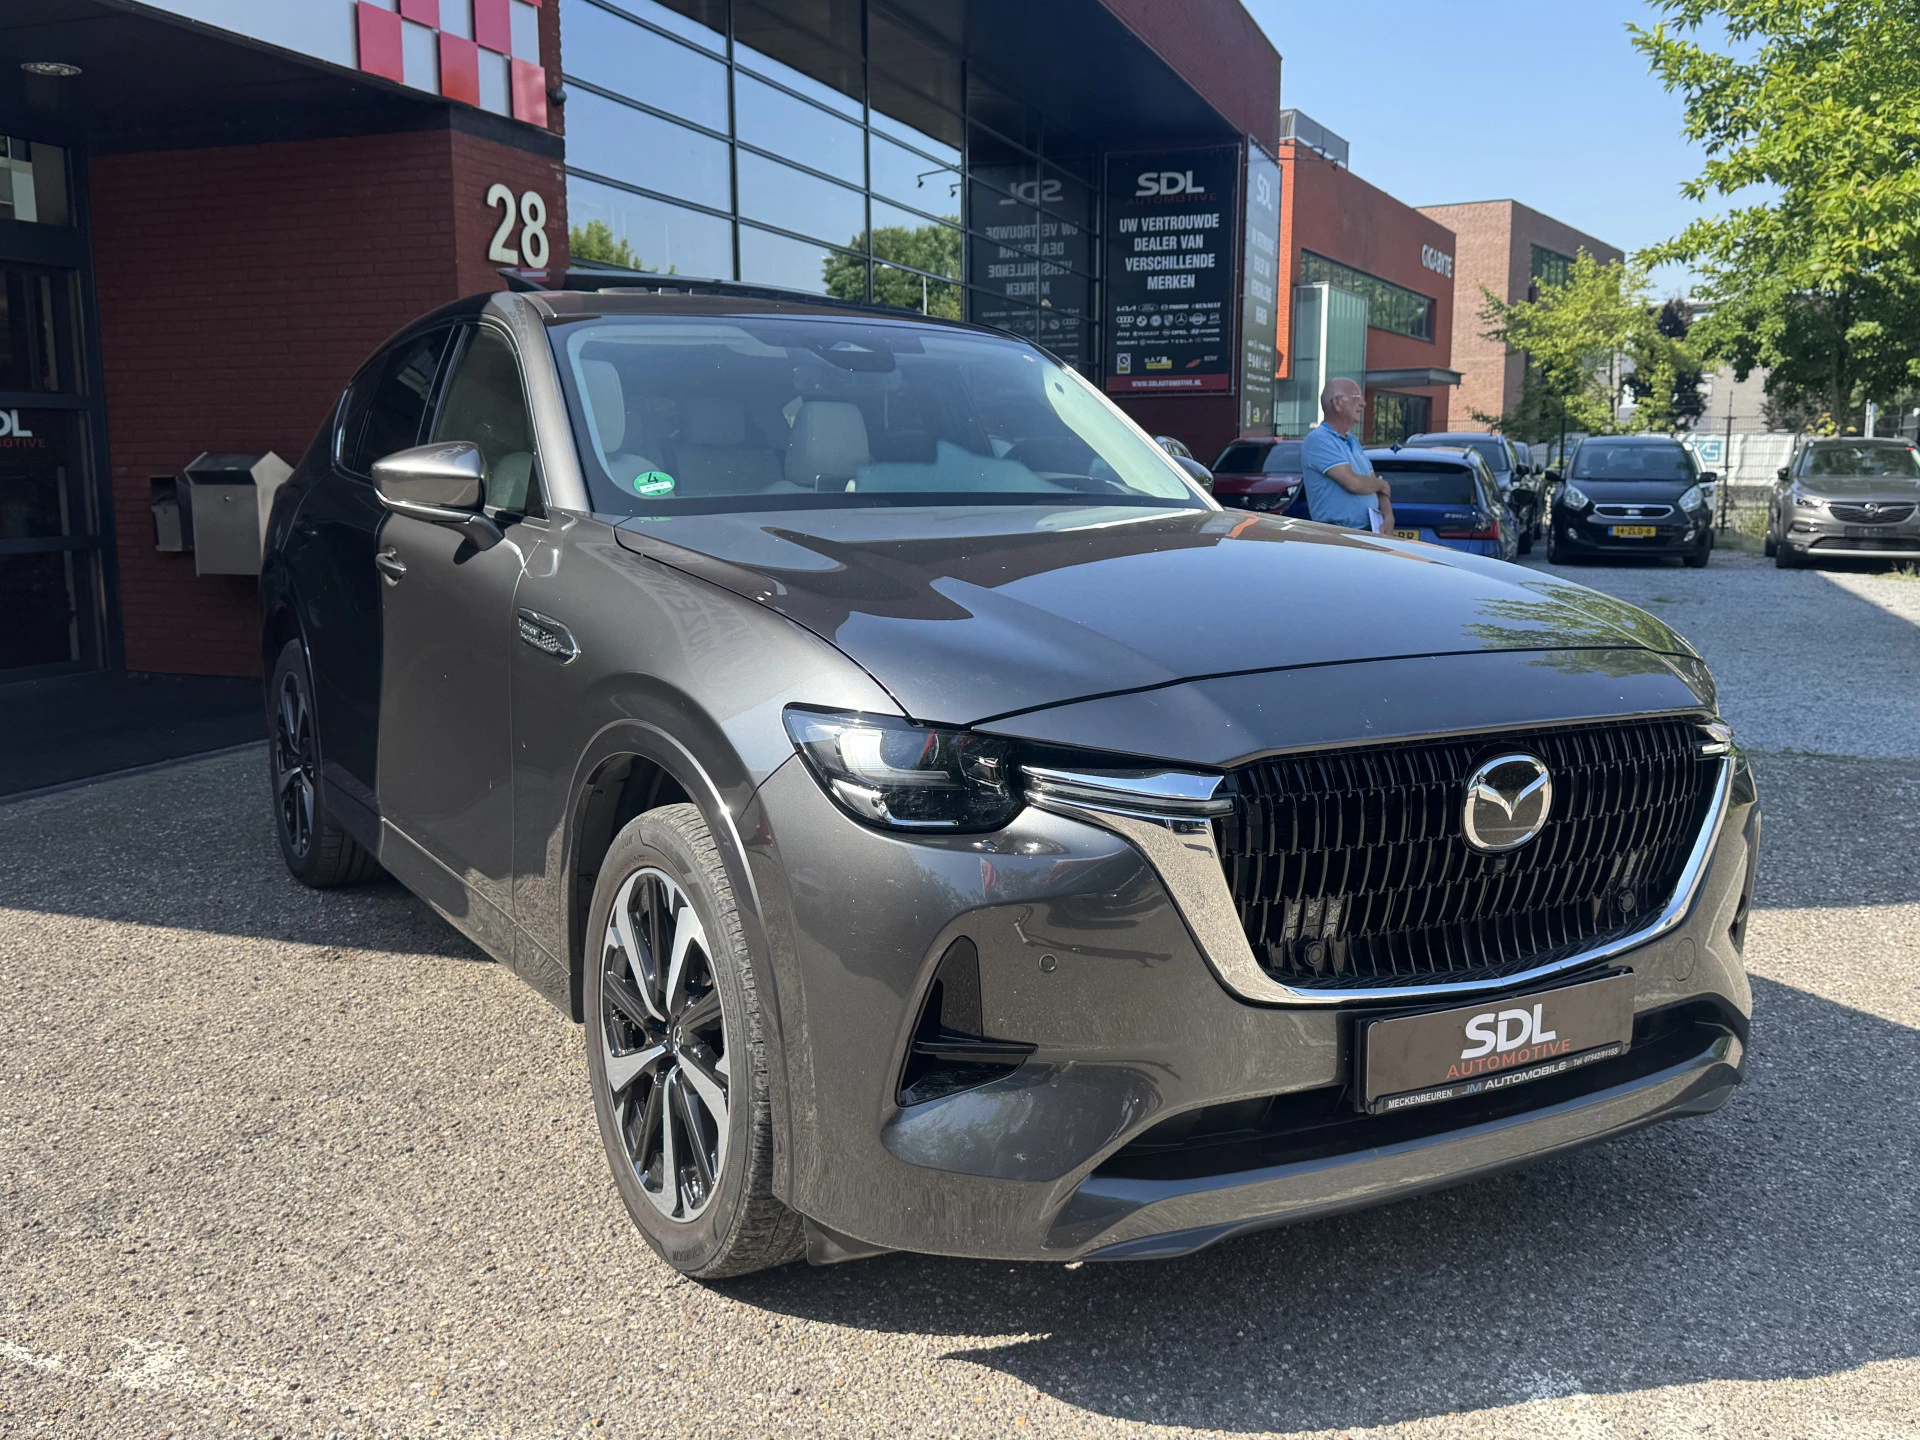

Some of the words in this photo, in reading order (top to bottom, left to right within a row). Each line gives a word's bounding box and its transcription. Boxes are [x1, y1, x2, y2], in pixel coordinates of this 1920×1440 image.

[1135, 170, 1205, 196] SDL
[1126, 192, 1217, 205] AUTOMOTIVE
[487, 183, 549, 269] 28
[1119, 218, 1138, 233] UW
[1141, 213, 1220, 231] VERTROUWDE
[1134, 235, 1177, 252] DEALER
[1180, 234, 1204, 249] VAN
[1125, 253, 1215, 271] VERSCHILLENDE
[1422, 244, 1452, 278] GIGABYTE
[1147, 274, 1195, 290] MERKEN
[1460, 1003, 1557, 1060] SDL
[1446, 1038, 1572, 1079] AUTOMOTIVE
[1388, 1088, 1453, 1109] MECKENBEUREN
[1461, 1082, 1482, 1095] JM
[1484, 1060, 1567, 1090] AUTOMOBILE
